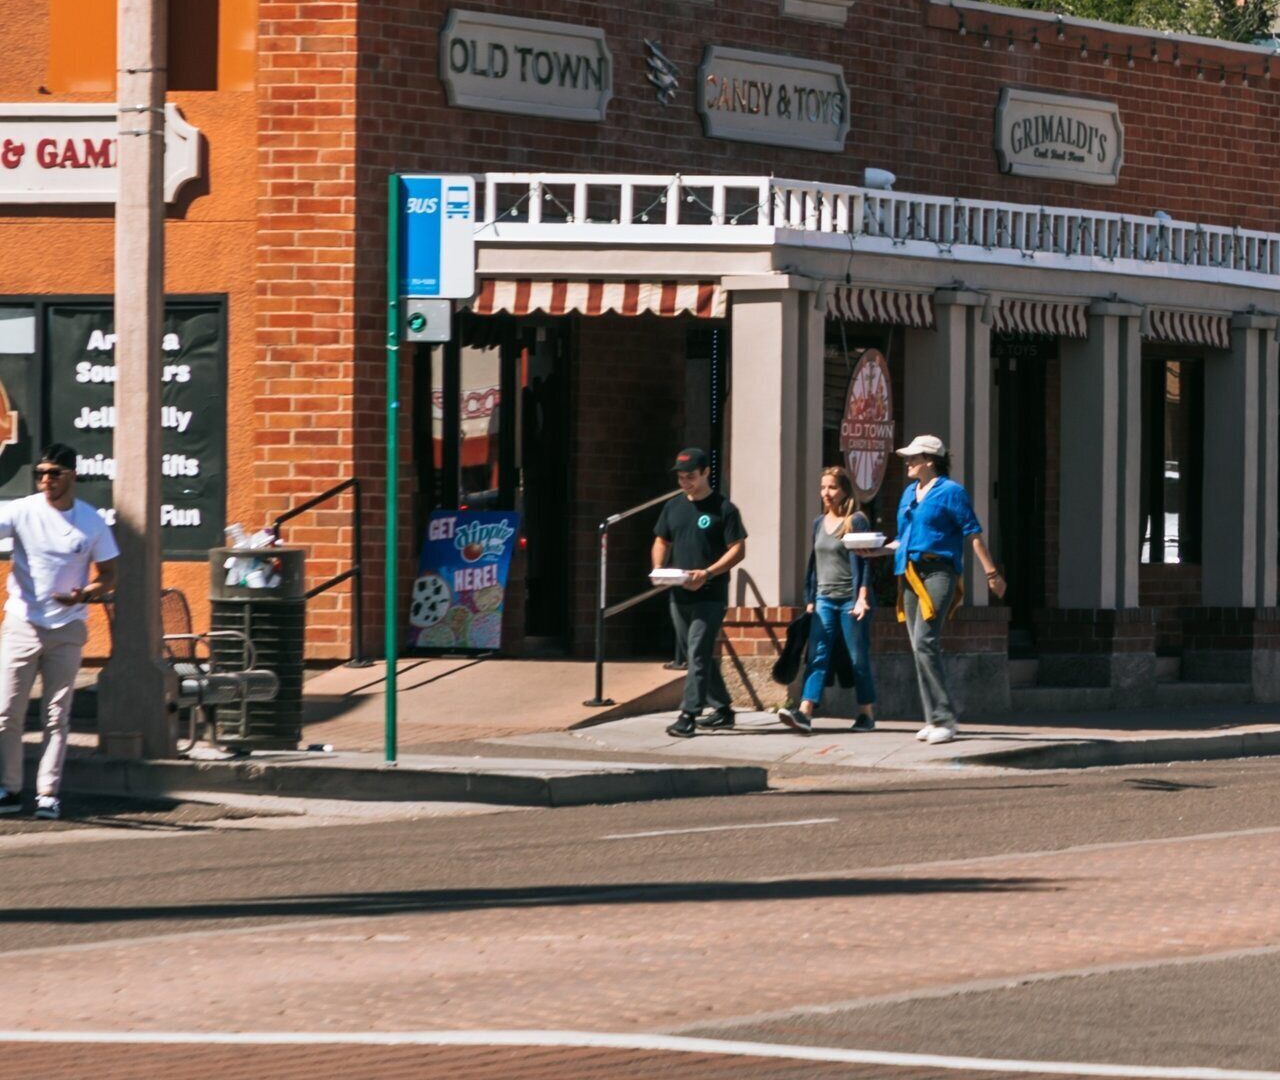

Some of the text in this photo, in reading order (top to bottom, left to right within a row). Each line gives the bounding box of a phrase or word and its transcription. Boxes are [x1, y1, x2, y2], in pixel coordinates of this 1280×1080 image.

[449, 36, 604, 92] OLD TOWN
[706, 74, 844, 126] CANDY & TOYS
[1010, 114, 1108, 164] GRIMALDI'S
[1, 138, 117, 169] & GAM
[407, 197, 439, 214] BUS
[841, 422, 894, 440] OLD TOWN
[160, 504, 201, 526] Fun
[428, 517, 457, 542] GET
[454, 565, 499, 593] HERE!
